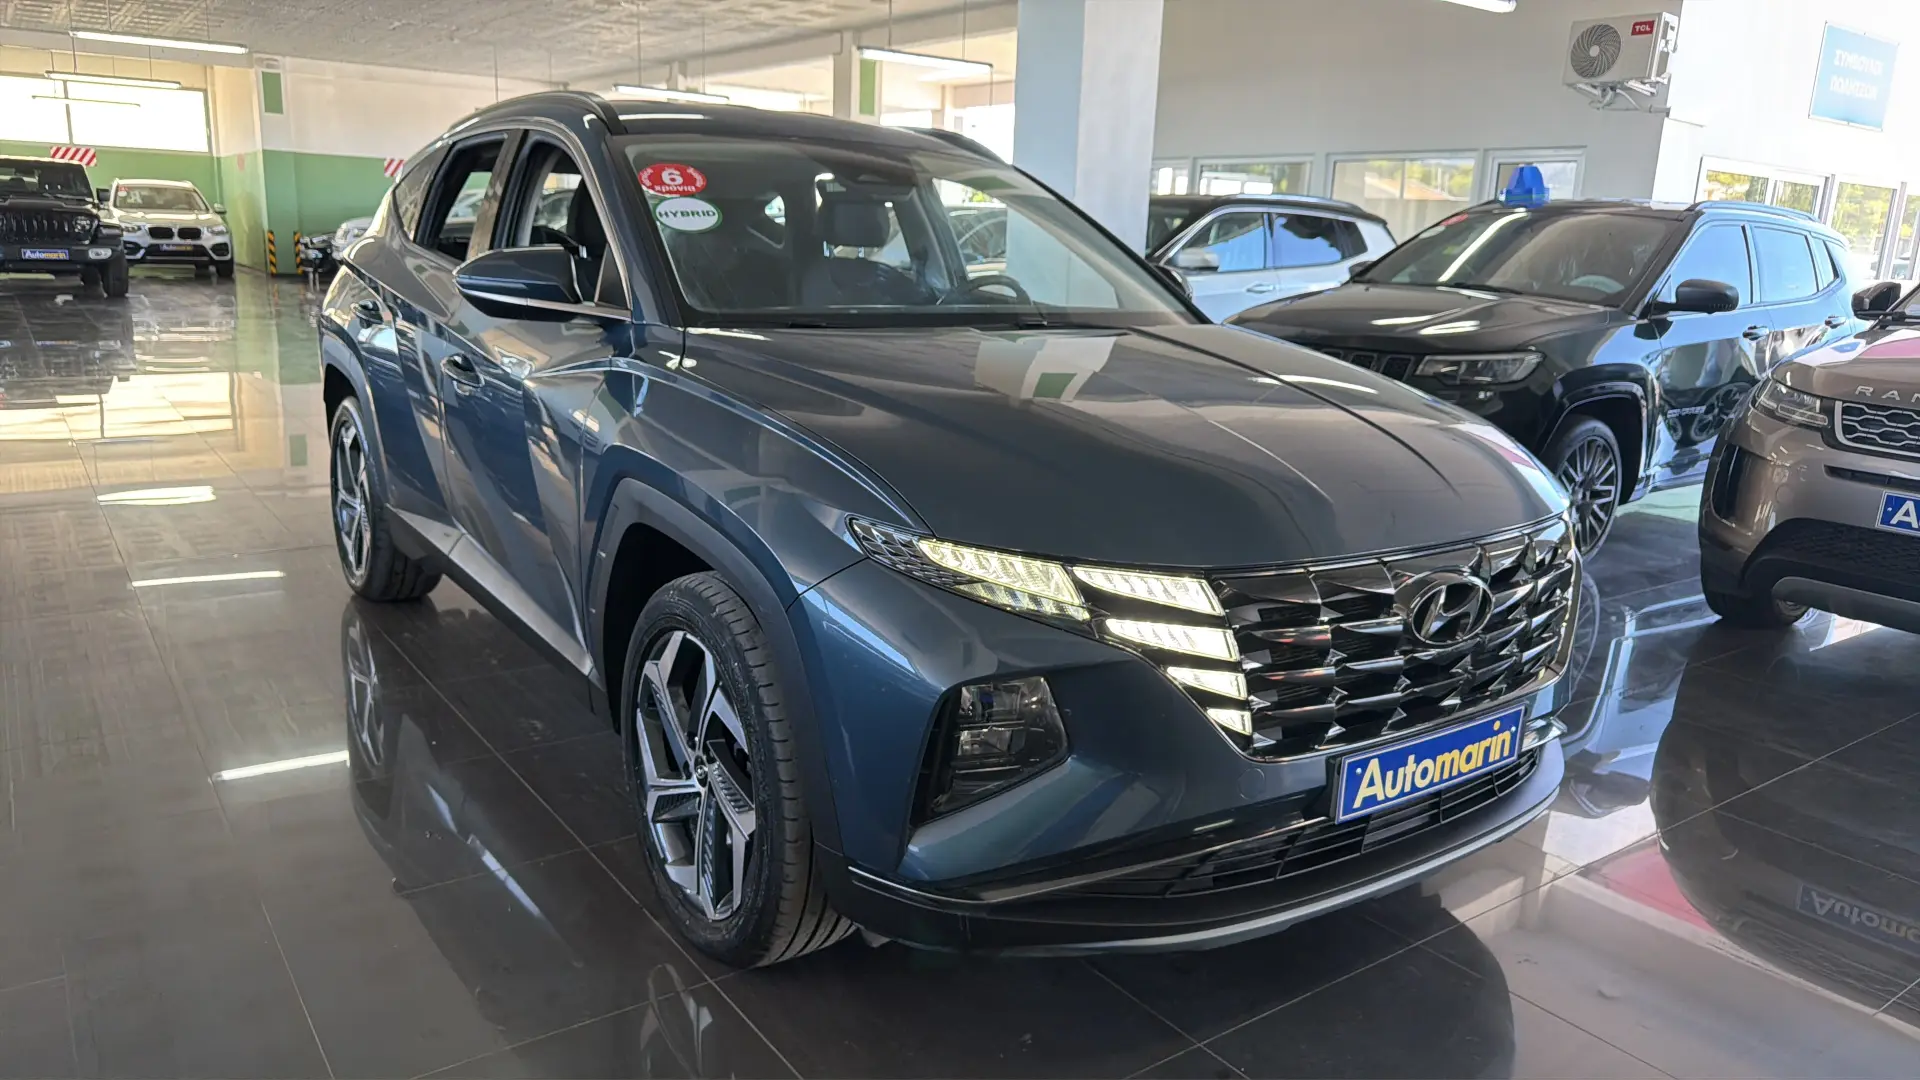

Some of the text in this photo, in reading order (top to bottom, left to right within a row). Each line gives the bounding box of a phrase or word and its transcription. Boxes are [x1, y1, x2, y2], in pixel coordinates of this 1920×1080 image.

[1635, 24, 1651, 32] TCL
[662, 168, 684, 186] 6
[658, 209, 716, 218] HYBRID
[1352, 720, 1512, 809] Automarin
